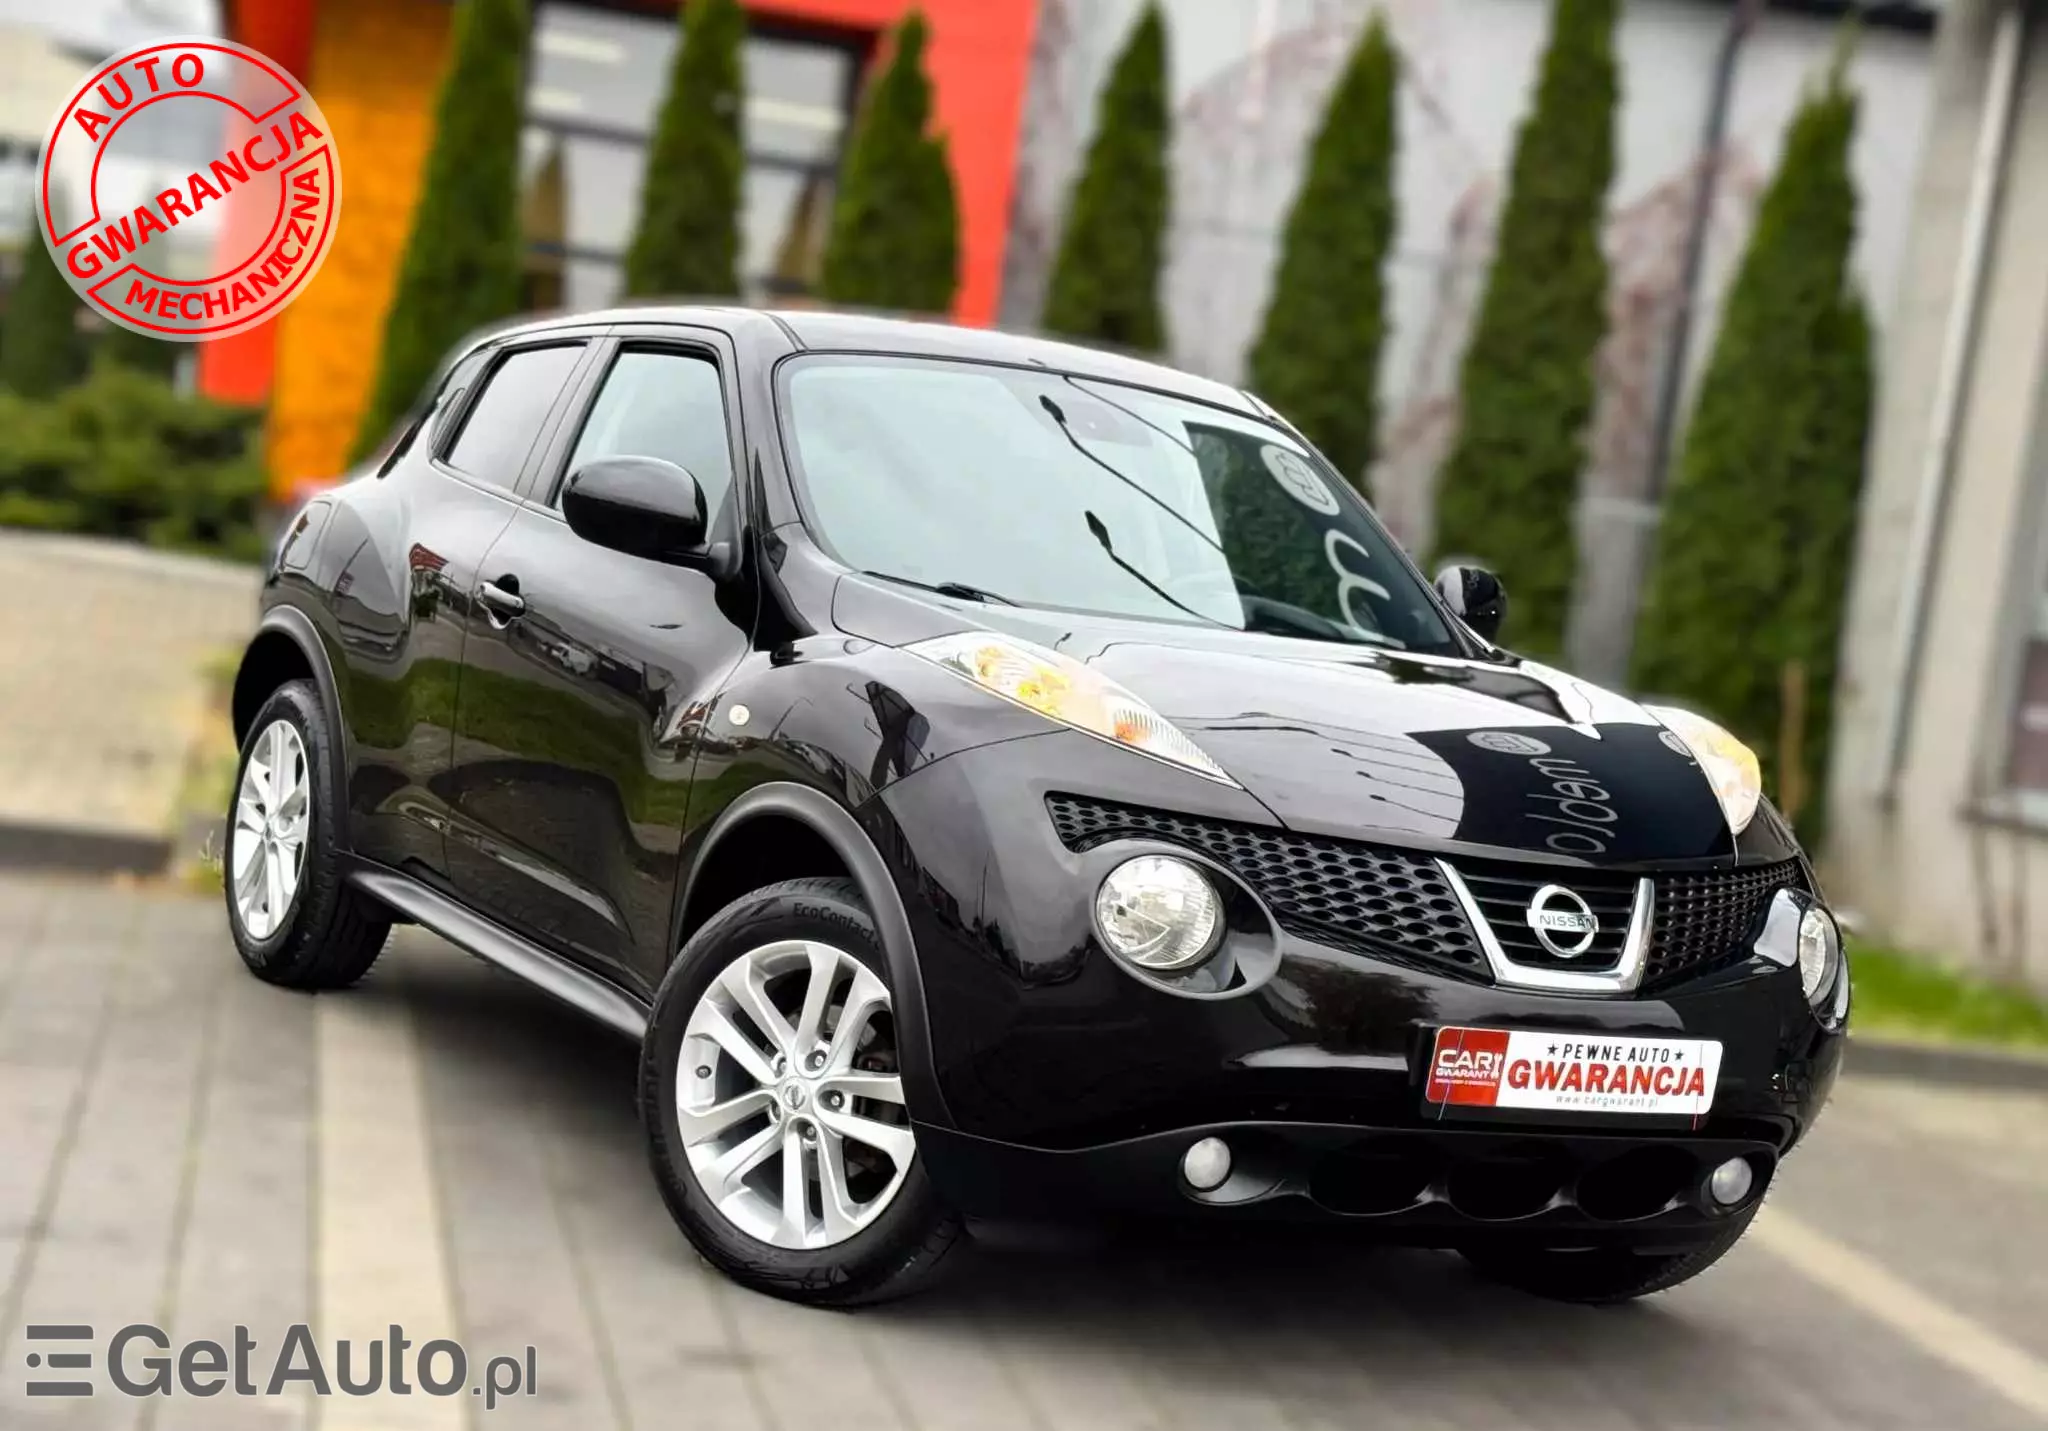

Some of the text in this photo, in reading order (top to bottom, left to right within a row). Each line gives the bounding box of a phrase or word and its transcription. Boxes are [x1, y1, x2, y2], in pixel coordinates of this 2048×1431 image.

[793, 902, 876, 943] EcoContact
[1539, 913, 1595, 929] NISSAN
[1563, 1043, 1670, 1063] PEWNE AUTO
[1507, 1059, 1704, 1097] GWARANCJA
